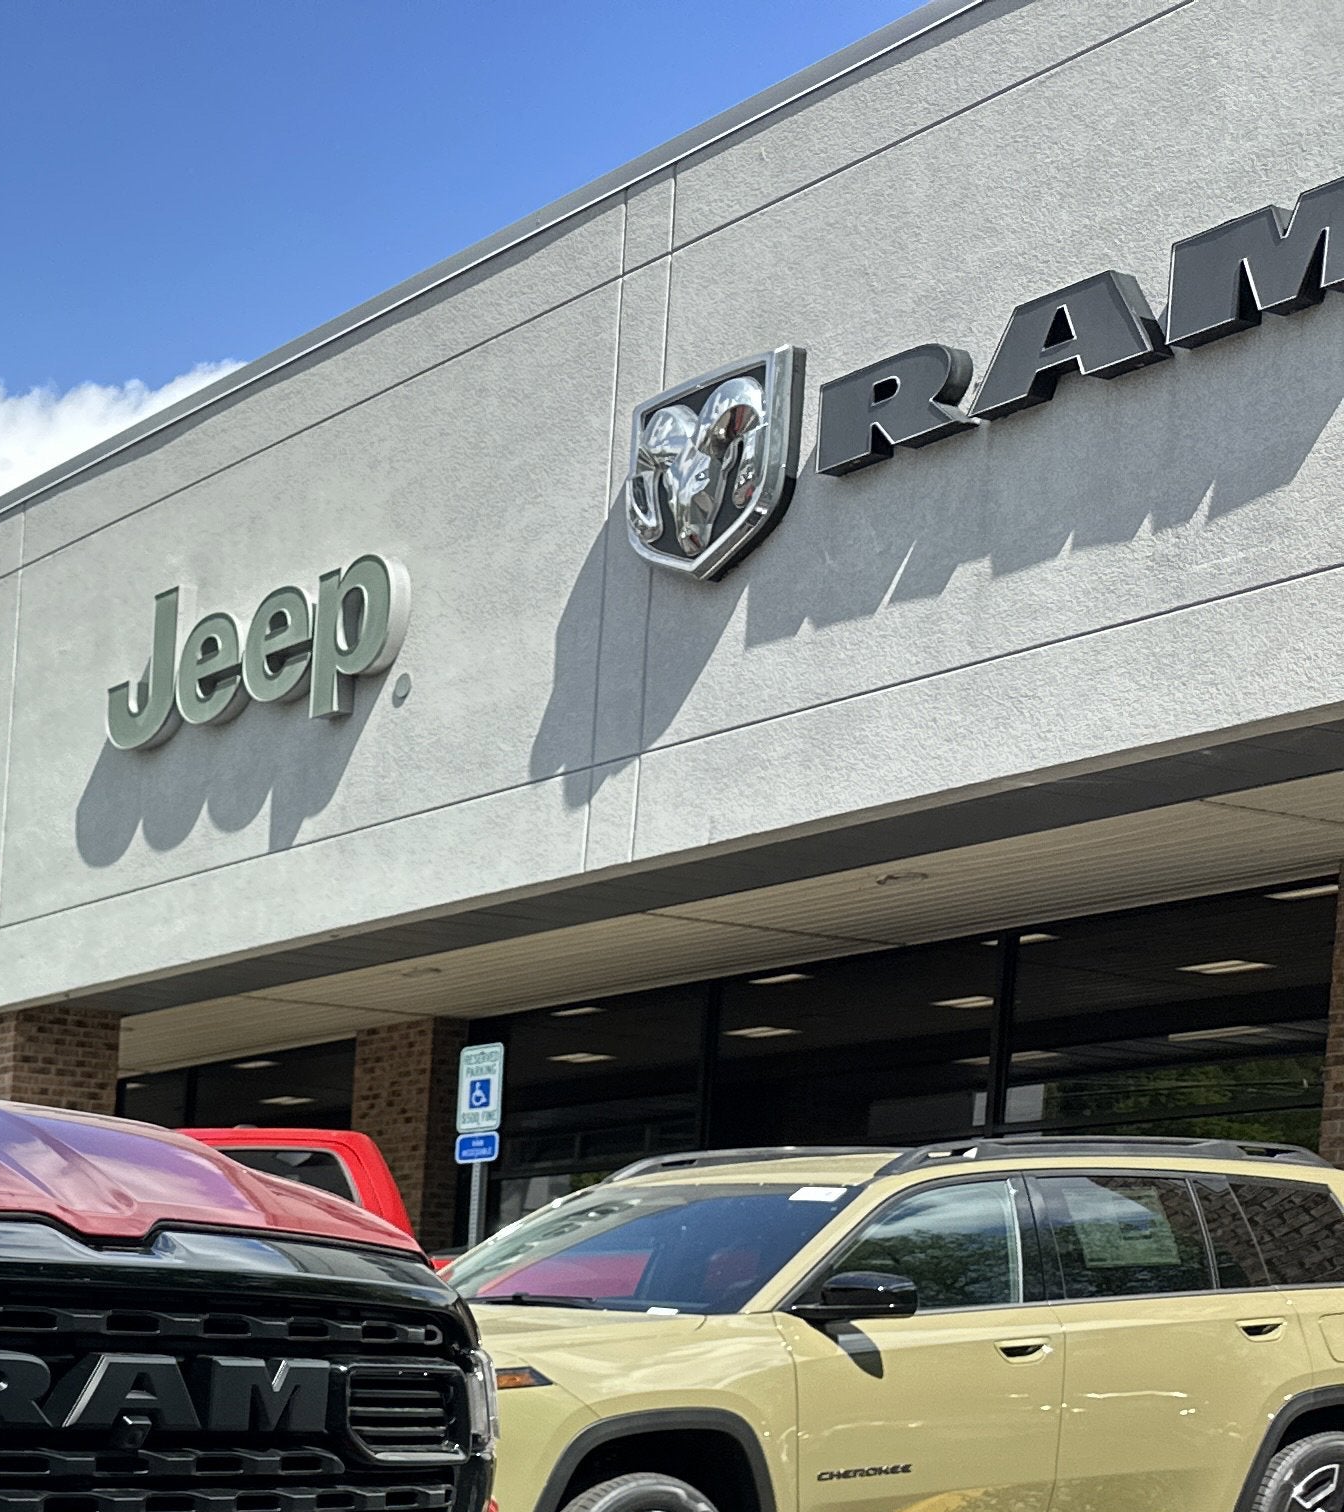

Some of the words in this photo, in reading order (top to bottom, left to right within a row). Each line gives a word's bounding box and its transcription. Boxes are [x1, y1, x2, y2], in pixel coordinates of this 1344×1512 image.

[816, 177, 1344, 476] RAM
[106, 554, 406, 750] Jeep
[817, 1464, 913, 1481] CHEROKEE
